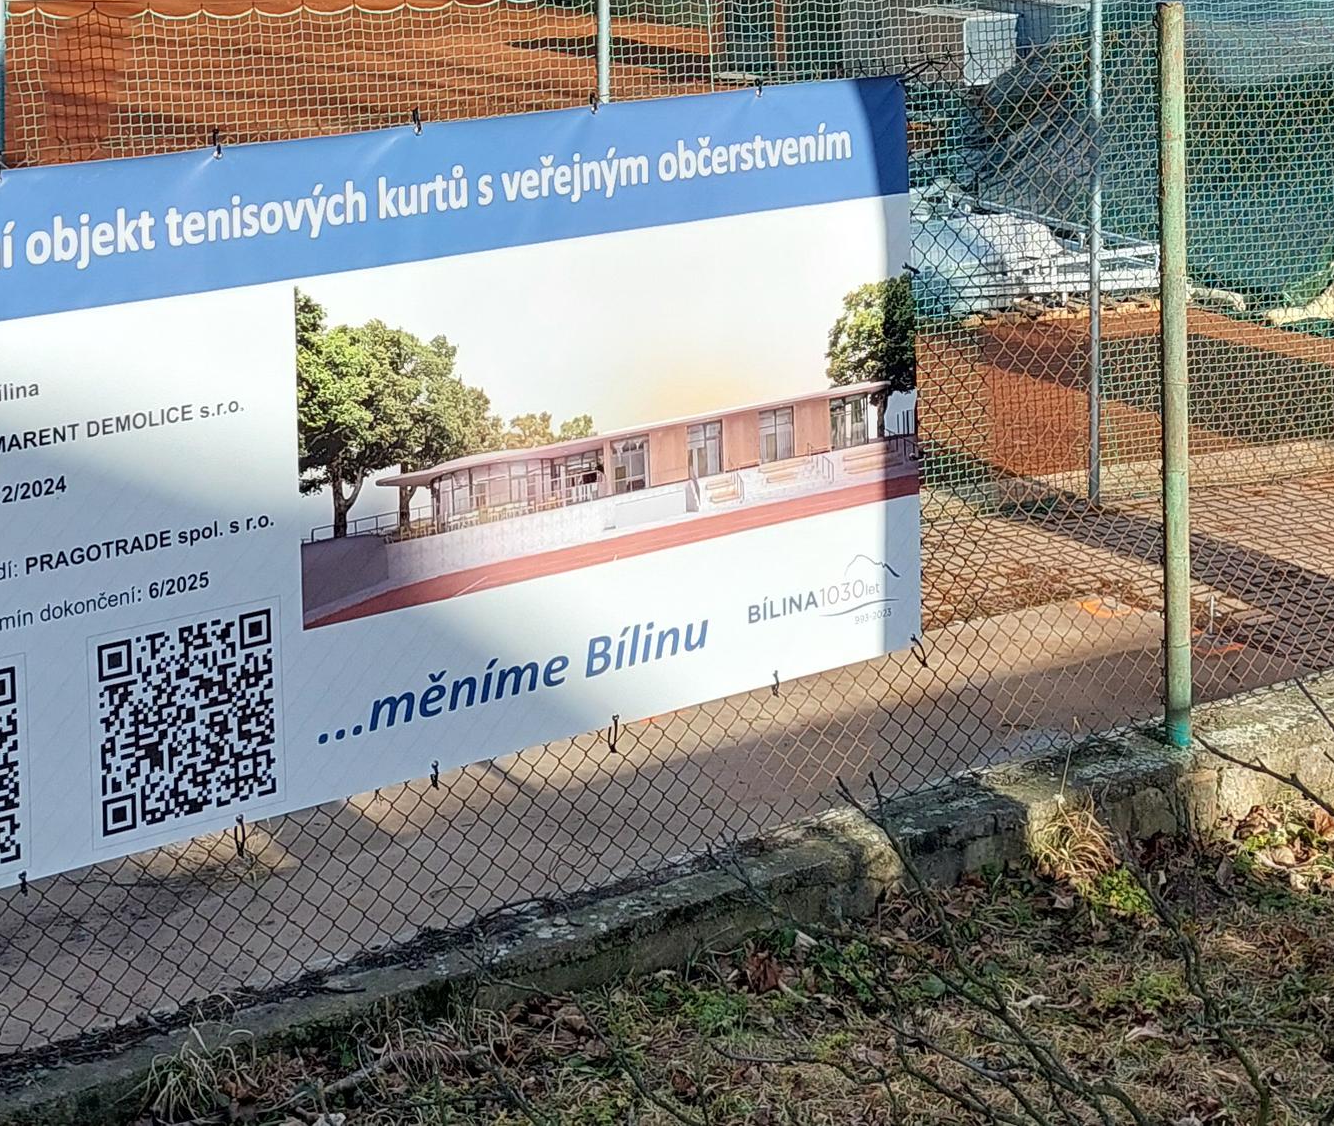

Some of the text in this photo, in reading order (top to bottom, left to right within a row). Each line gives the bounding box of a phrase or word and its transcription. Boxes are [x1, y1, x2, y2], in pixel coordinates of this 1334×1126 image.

[26, 208, 156, 270] objekt
[165, 180, 367, 247] tenisových
[378, 165, 468, 220] kurtů
[477, 174, 494, 206] s
[501, 147, 649, 203] veřejným
[658, 122, 852, 182] občerstvením
[86, 404, 193, 438] DEMOLICE
[199, 400, 244, 419] s.r.o.
[0, 475, 67, 504] 2/2024
[24, 530, 172, 575] PRAGOTRADE
[177, 521, 223, 546] spol.
[229, 520, 240, 534] s
[245, 514, 275, 532] r.o.
[39, 586, 143, 622] dokončení:
[148, 571, 210, 600] 6/2025
[317, 619, 709, 746] ...měníme Bílinu
